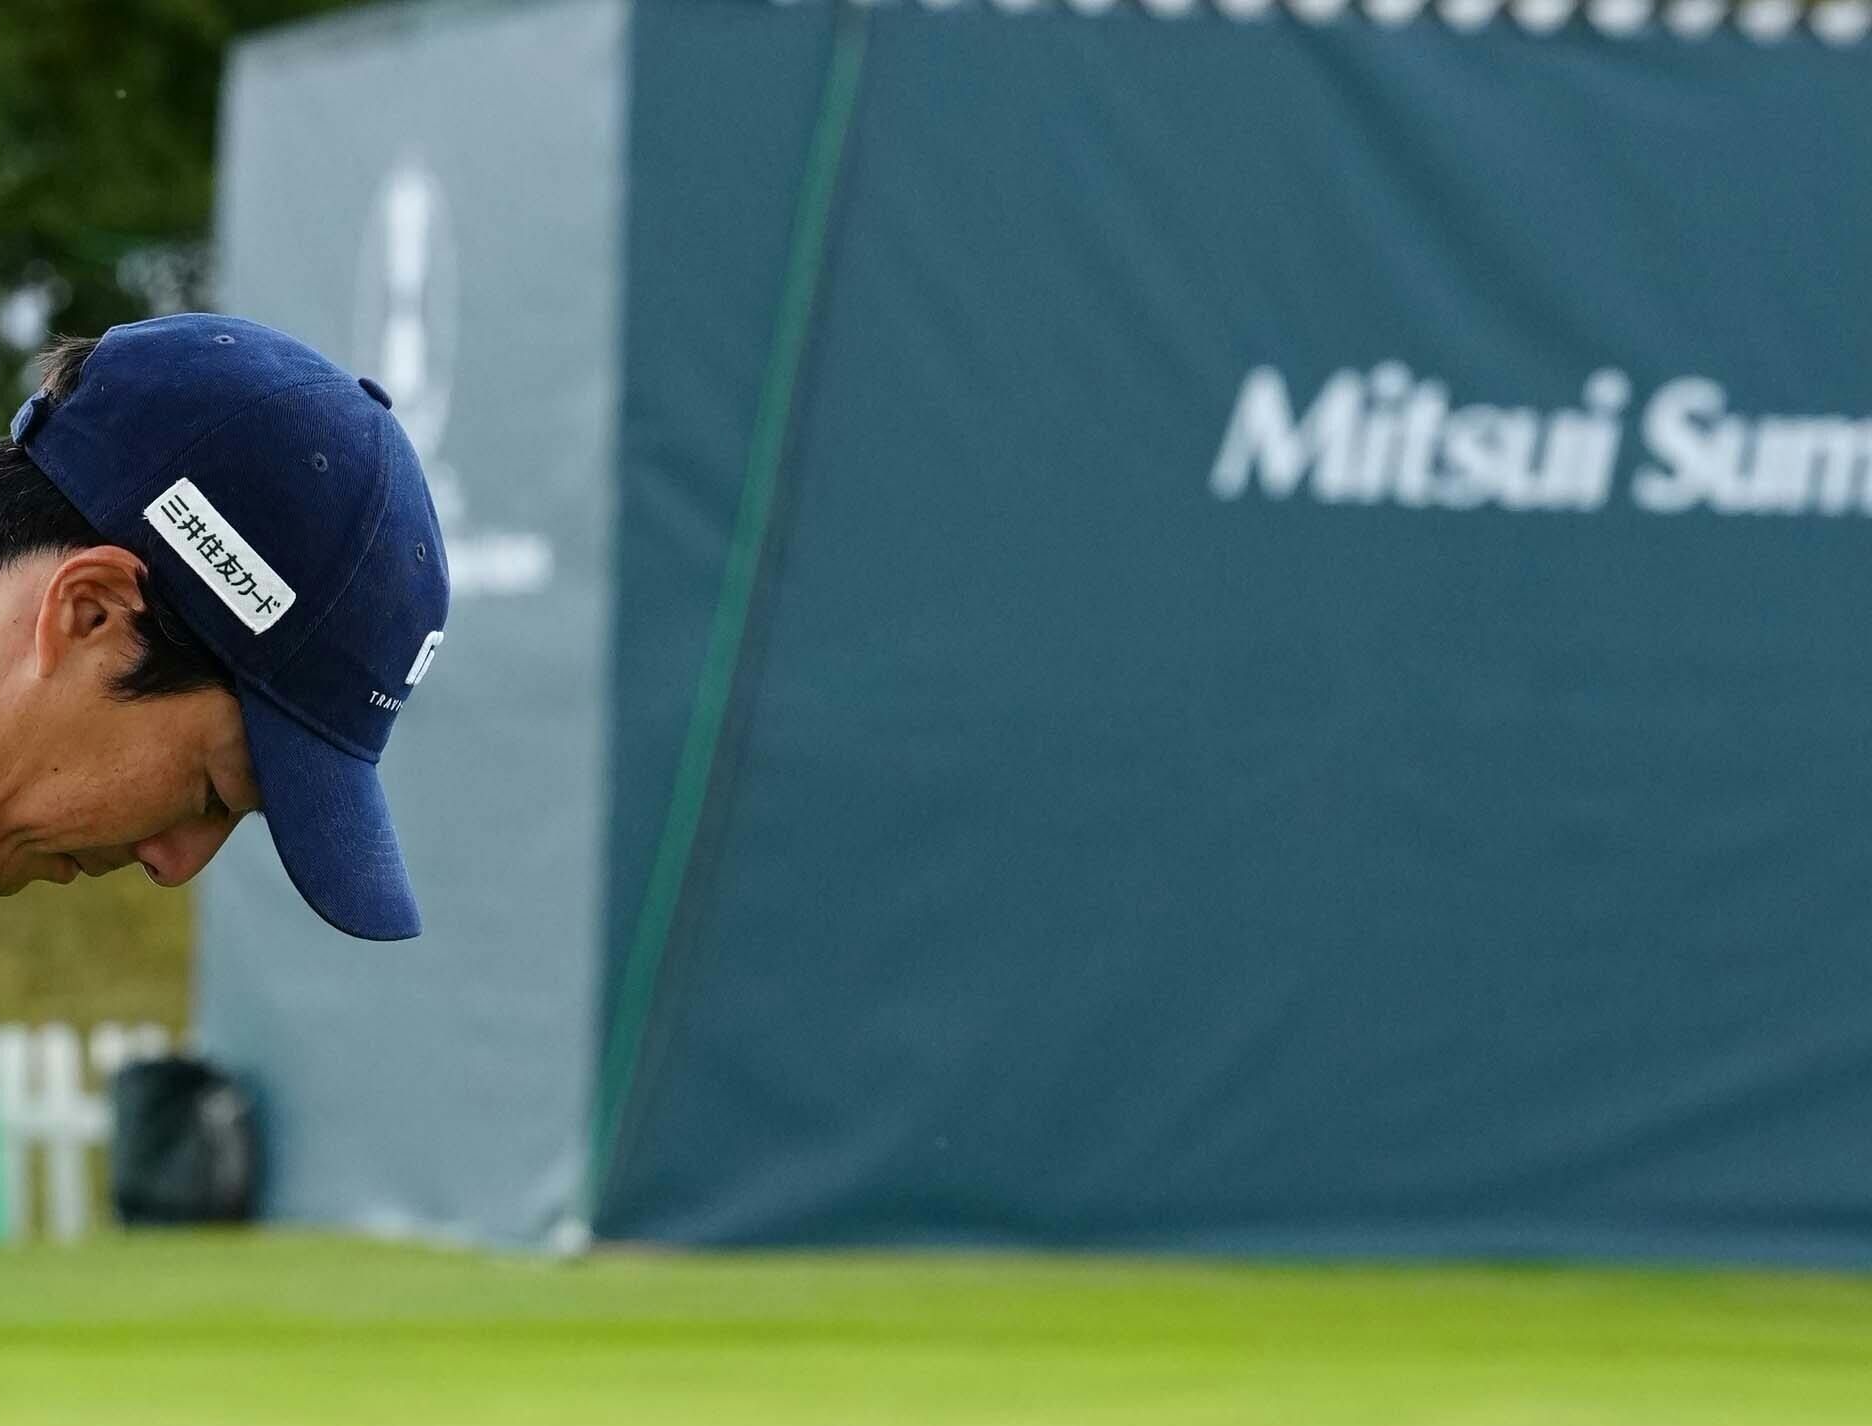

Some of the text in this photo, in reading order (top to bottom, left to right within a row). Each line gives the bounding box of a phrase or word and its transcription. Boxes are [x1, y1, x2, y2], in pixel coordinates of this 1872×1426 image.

[1208, 360, 1626, 512] Mitsui
[160, 494, 281, 615] 三井住友カード
